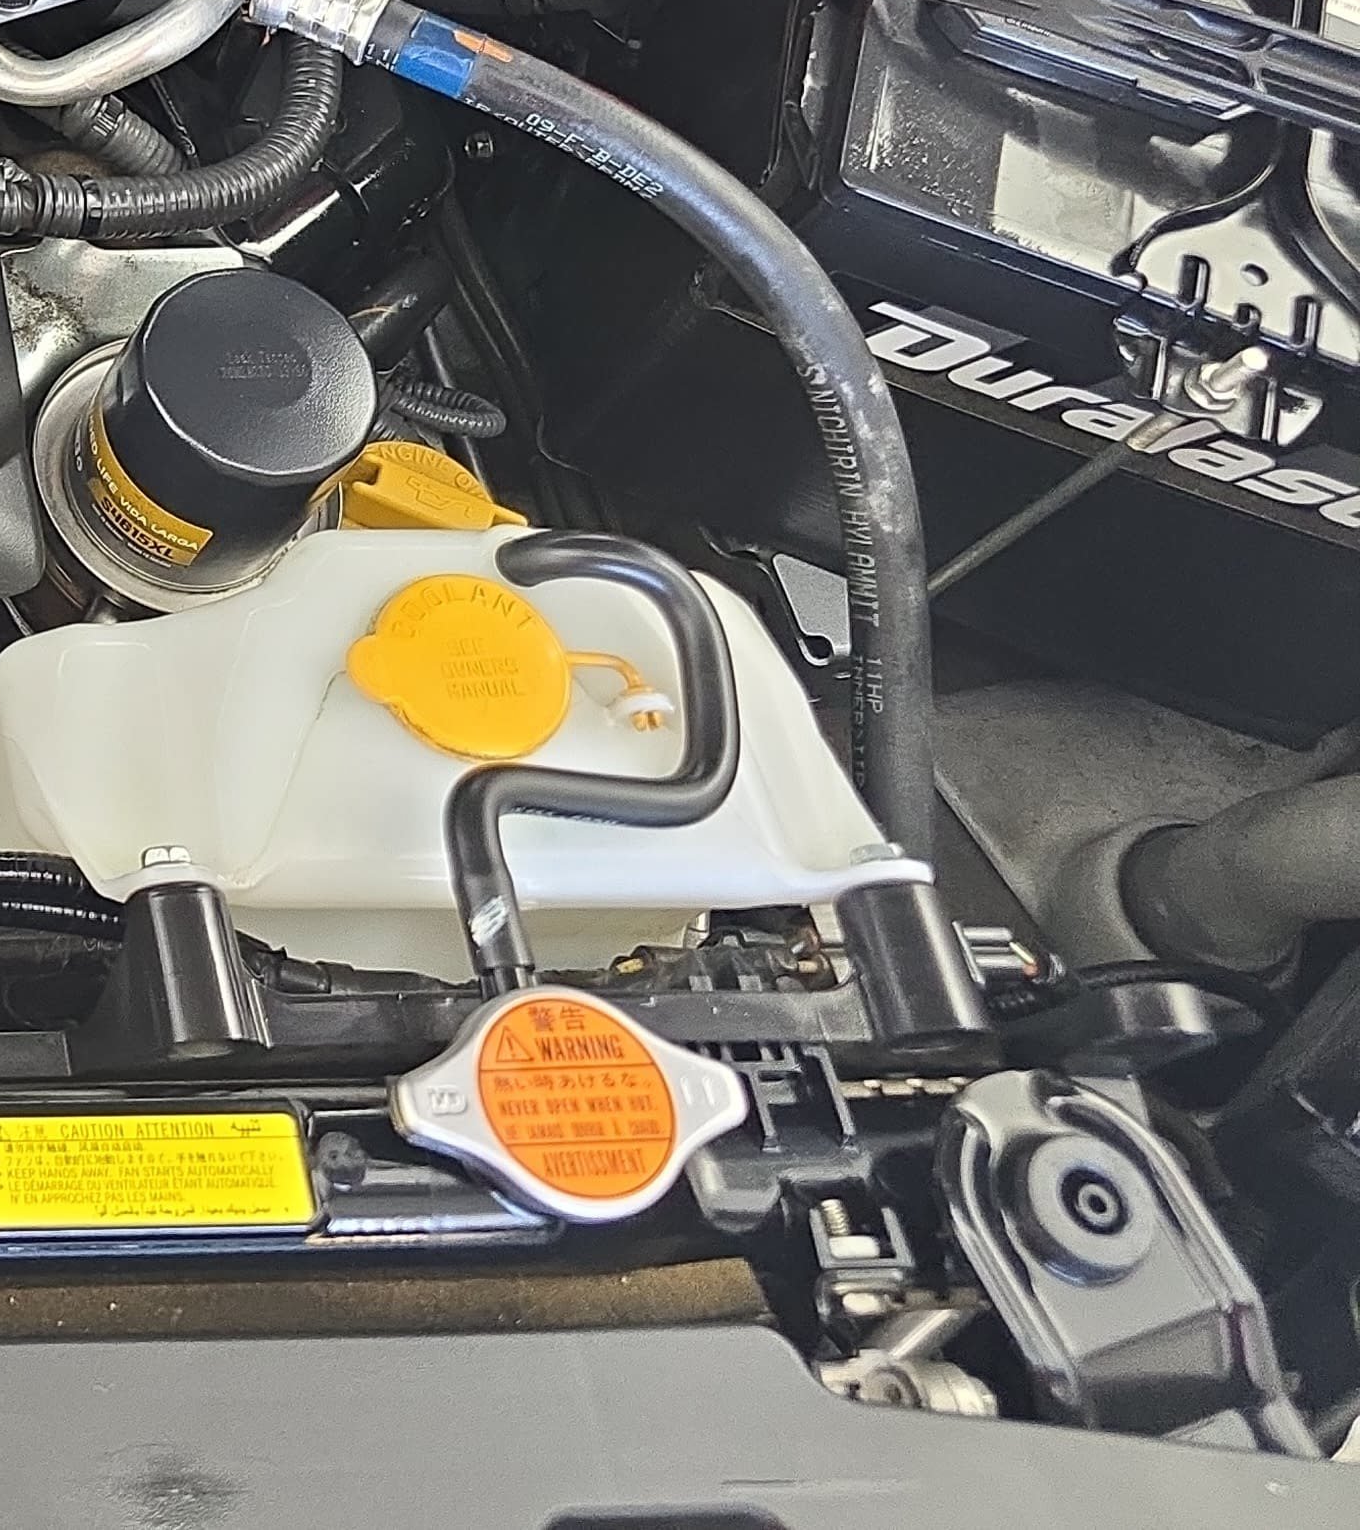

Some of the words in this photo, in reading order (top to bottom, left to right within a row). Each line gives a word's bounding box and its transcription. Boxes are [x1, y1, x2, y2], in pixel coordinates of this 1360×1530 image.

[806, 389, 864, 498] NICHIRIN
[95, 458, 118, 495] LIFE
[119, 496, 148, 528] VIDA
[150, 521, 200, 552] LARGA
[392, 581, 538, 639] COOLANT
[445, 637, 487, 657] SEE
[446, 679, 527, 698] MANUAL
[527, 1006, 586, 1032] 警告
[535, 1034, 624, 1063] WARNING
[497, 1100, 539, 1118] NEVER
[60, 1123, 125, 1139] CAUTION
[136, 1122, 215, 1138] ATTENTION
[7, 1168, 36, 1180] KEEP
[39, 1167, 78, 1179] HANDS
[118, 1166, 140, 1178] FAN
[143, 1165, 184, 1177] STARTS
[8, 1180, 23, 1191] LE
[41, 1192, 101, 1204] APPROCHEZ
[104, 1191, 125, 1203] PAS
[127, 1191, 146, 1203] LES
